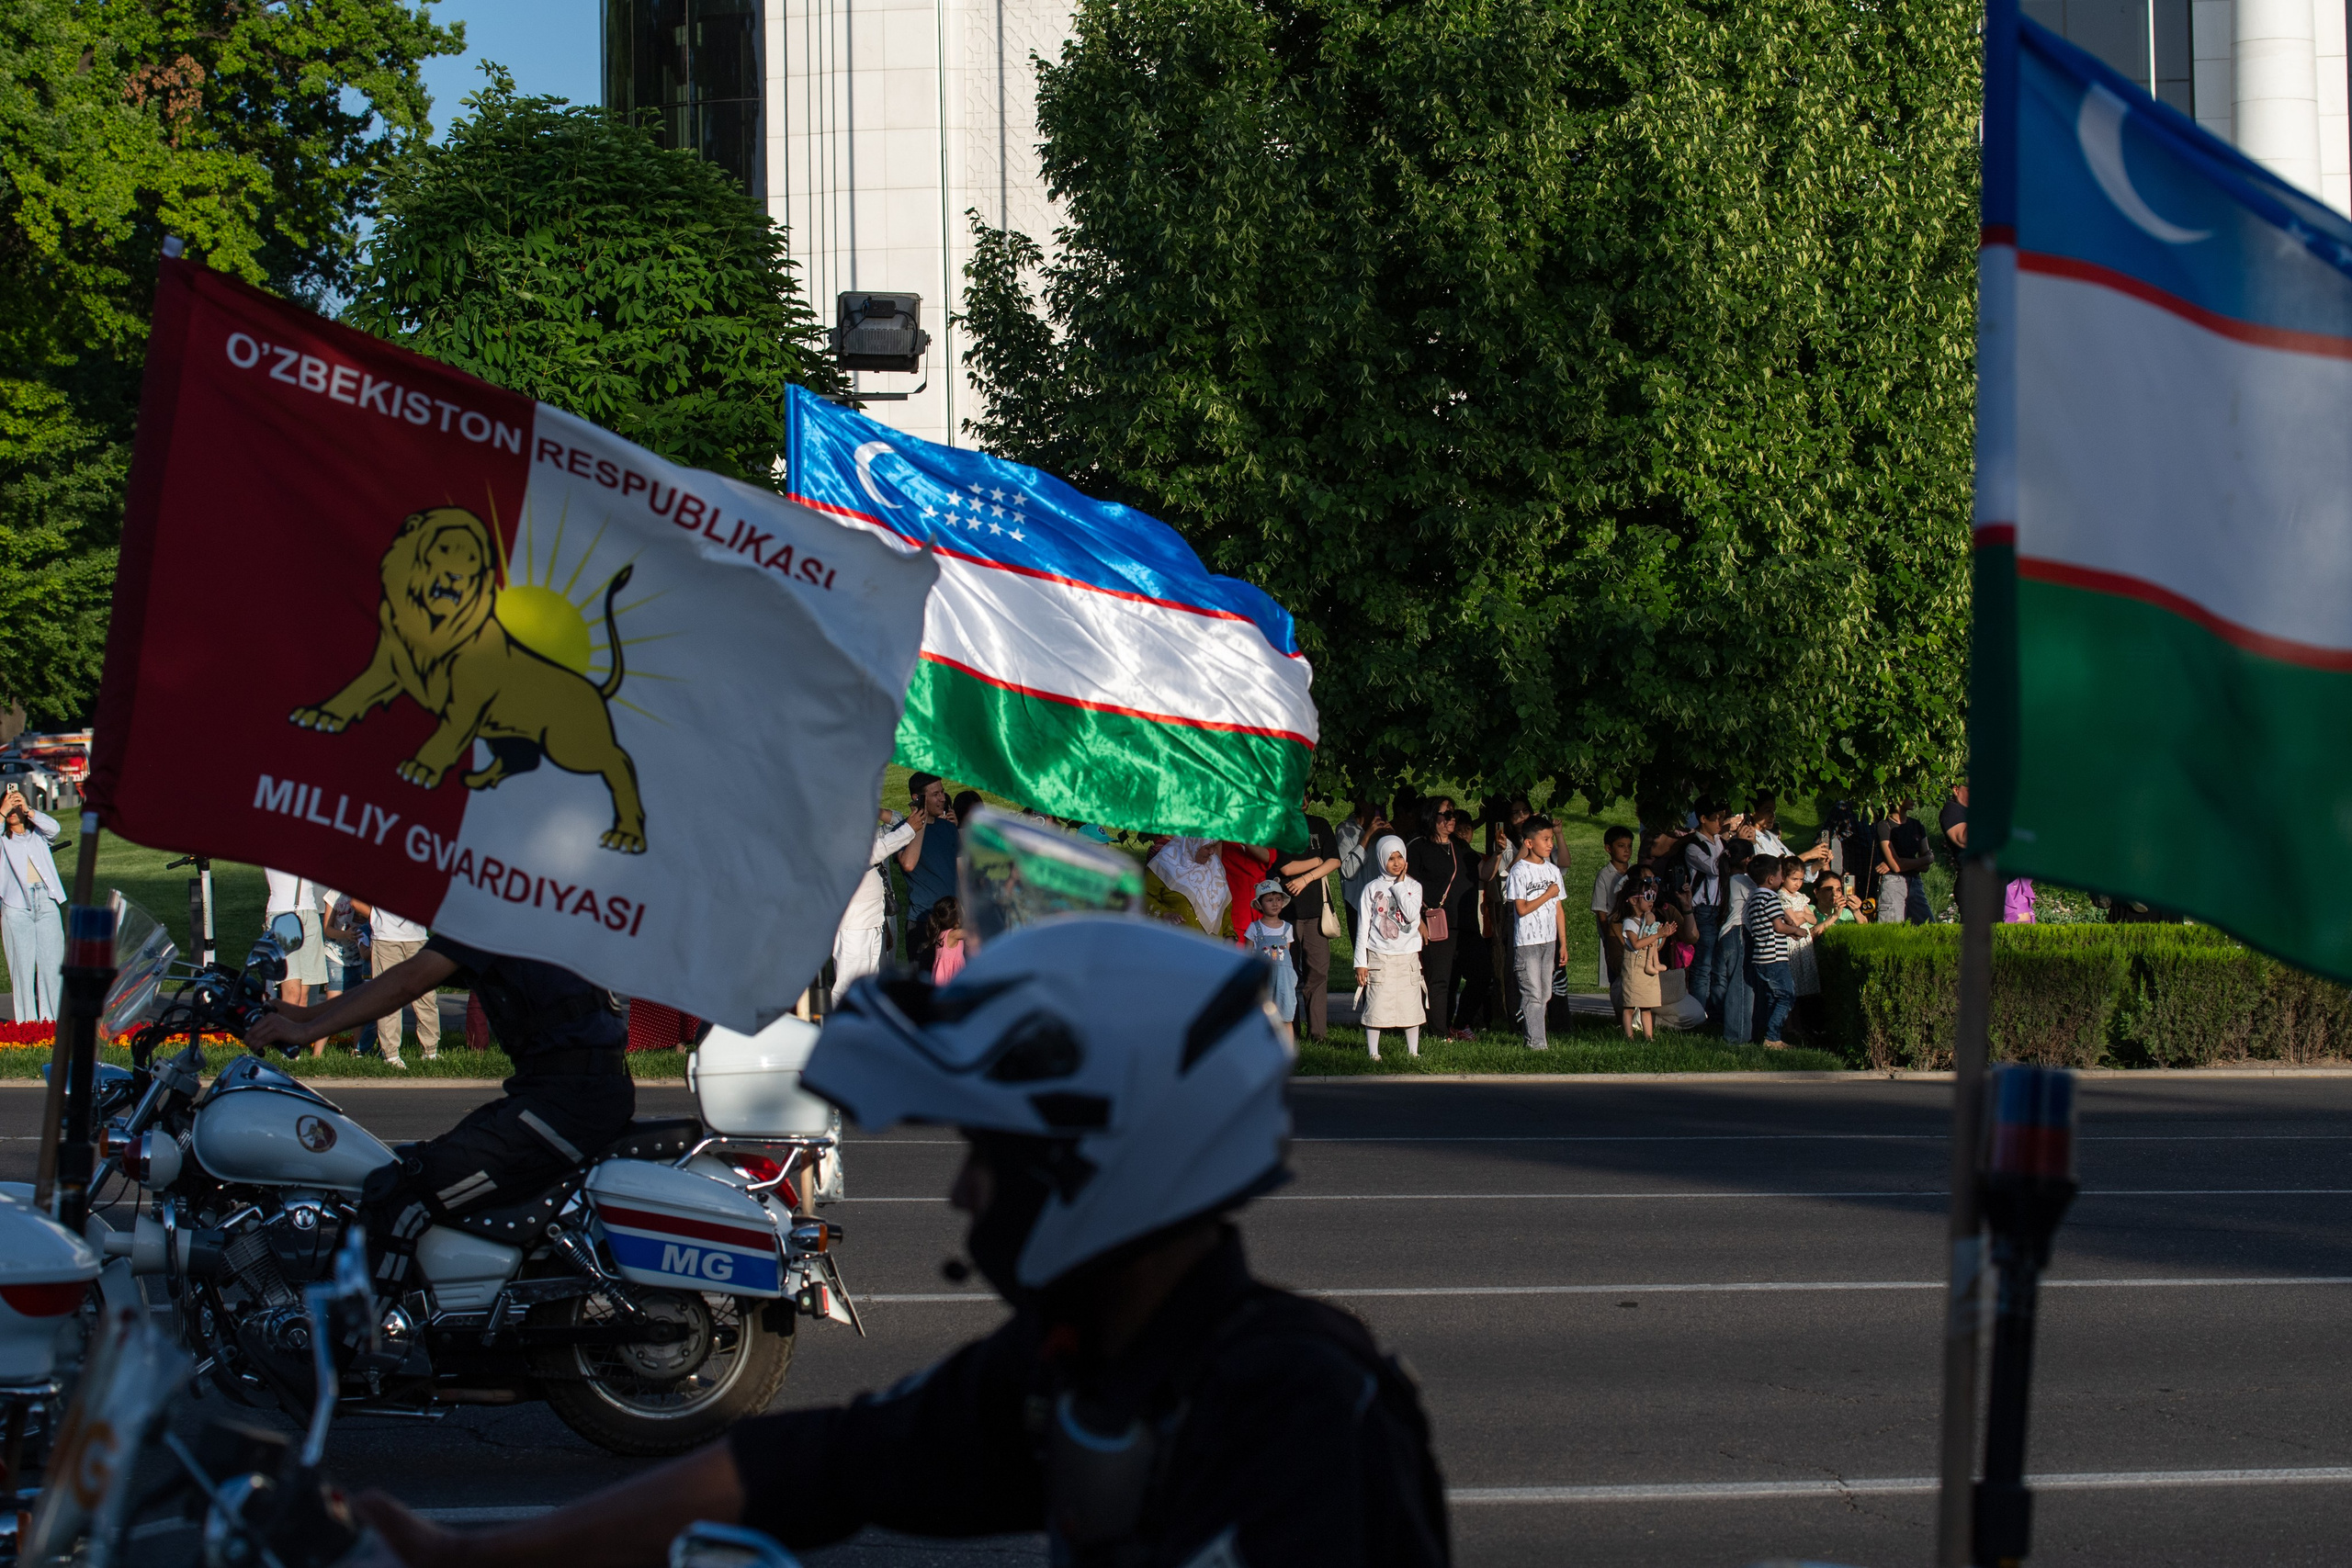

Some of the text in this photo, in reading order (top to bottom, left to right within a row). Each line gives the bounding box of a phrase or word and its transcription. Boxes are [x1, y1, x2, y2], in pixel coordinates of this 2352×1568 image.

[536, 437, 837, 591] RESPUBLIKASI
[253, 773, 646, 937] MILLIY GVARDIYASI
[662, 1244, 734, 1280] MG
